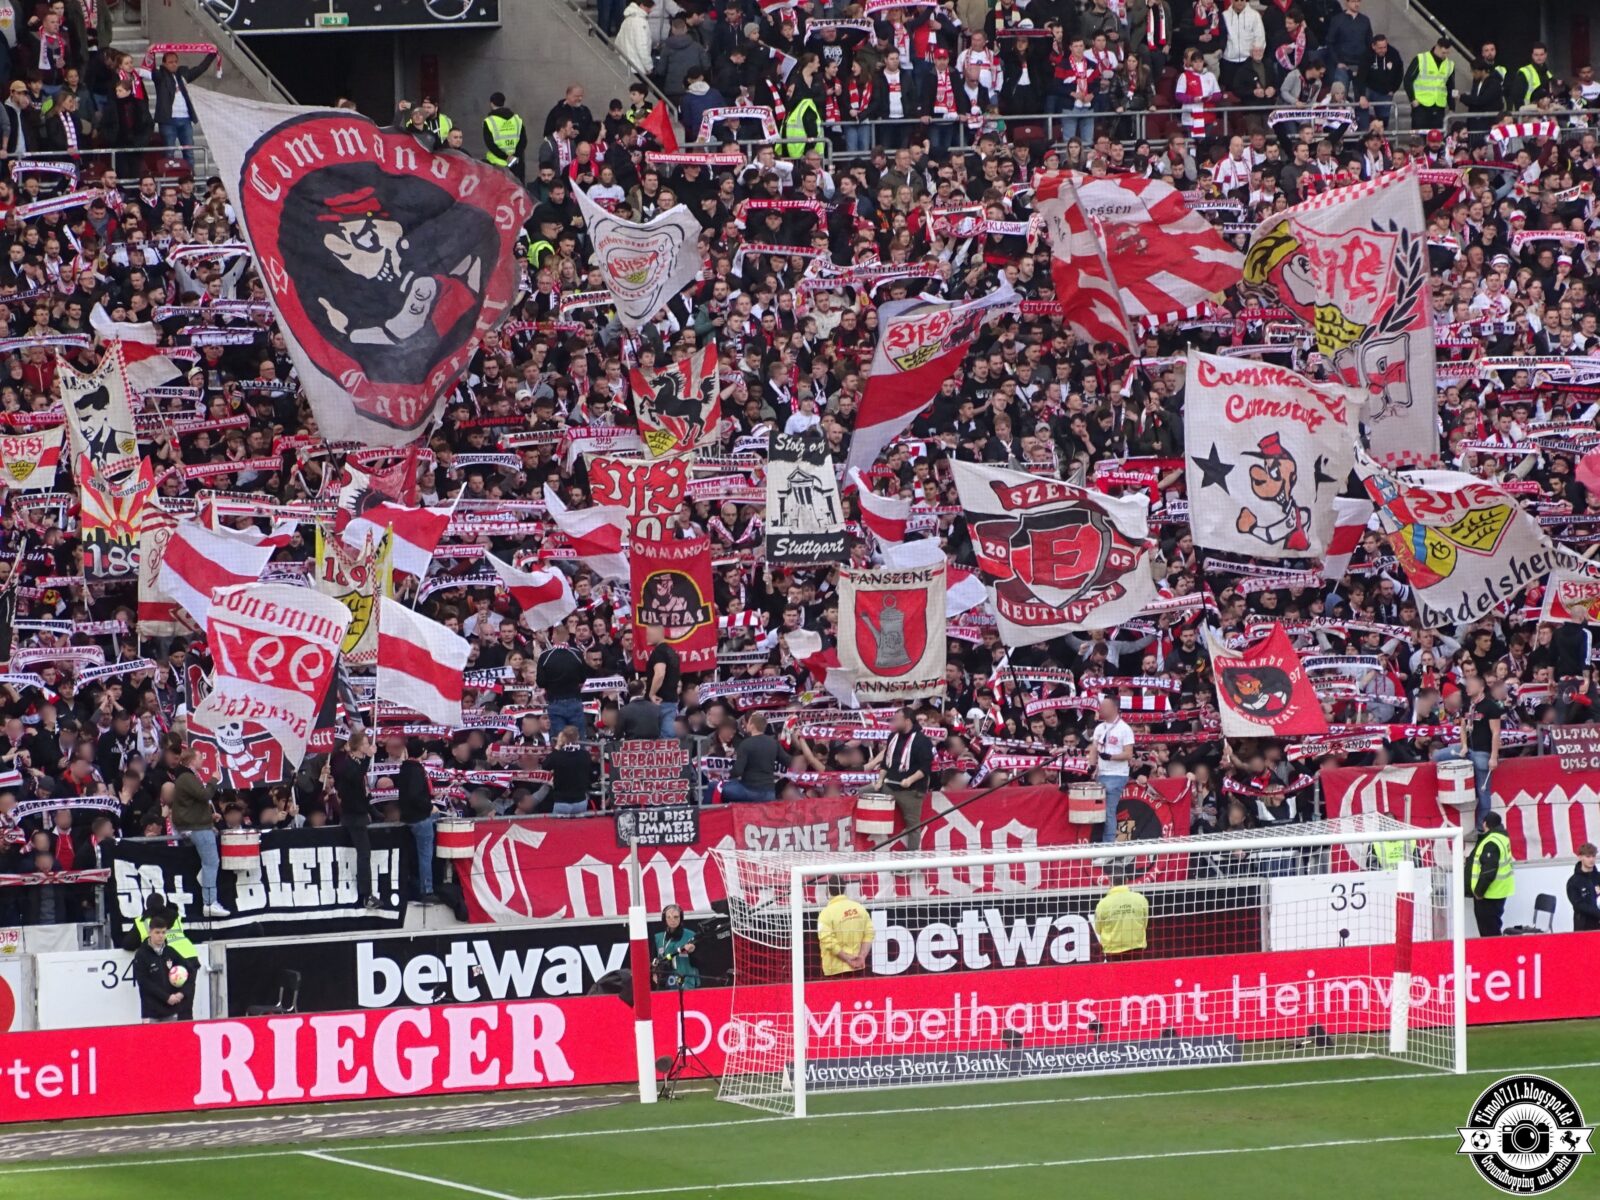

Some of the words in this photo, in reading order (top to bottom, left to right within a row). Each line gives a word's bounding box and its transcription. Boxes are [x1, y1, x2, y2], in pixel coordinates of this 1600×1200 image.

[811, 19, 872, 29] STUTTGART
[251, 126, 480, 202] Commando
[649, 153, 707, 163] CANNSTATTER
[714, 153, 743, 164] KURVE
[1488, 356, 1566, 364] CANNSTATTER
[154, 388, 184, 397] WEISS
[774, 433, 806, 459] Stolz
[186, 460, 246, 477] CANNSTATTER
[252, 457, 282, 471] KURVE
[774, 537, 845, 560] Stuttgart
[984, 541, 1006, 558] 20
[1109, 552, 1132, 568] 05
[431, 574, 497, 588] STUTTGART
[850, 569, 933, 585] FANSZENE
[640, 608, 705, 627] ULTRAS
[83, 666, 113, 680] IMMER
[115, 661, 146, 673] WEISS
[1288, 667, 1302, 684] 97
[403, 724, 446, 735] SZENE
[1404, 727, 1429, 737] CC
[620, 738, 680, 752] JEDER
[1300, 744, 1328, 755] COMM
[1343, 739, 1372, 750] ANDO
[1556, 743, 1584, 755] DER
[611, 749, 690, 769] VERBANNTE
[1561, 757, 1588, 769] UMS
[619, 767, 683, 781] KEHRT
[12, 800, 57, 817] NECKAR
[75, 798, 122, 812] STADION
[638, 811, 659, 822] DU
[664, 809, 694, 822] BIST
[638, 821, 695, 834] IMMER
[639, 834, 660, 844] BEI
[664, 832, 697, 844] UNS!
[1330, 882, 1367, 912] 35
[101, 959, 138, 990] 34
[357, 939, 631, 1009] betway
[676, 1010, 777, 1057] Das
[804, 991, 1098, 1048] Möbelhaus
[1121, 977, 1209, 1028] mit
[192, 1002, 575, 1106] RIEGER
[1024, 1043, 1175, 1070] Mercedes-Benz
[1180, 1039, 1234, 1061] Bank
[803, 1059, 951, 1084] Mercedes-Benz
[954, 1052, 1010, 1075] Bank
